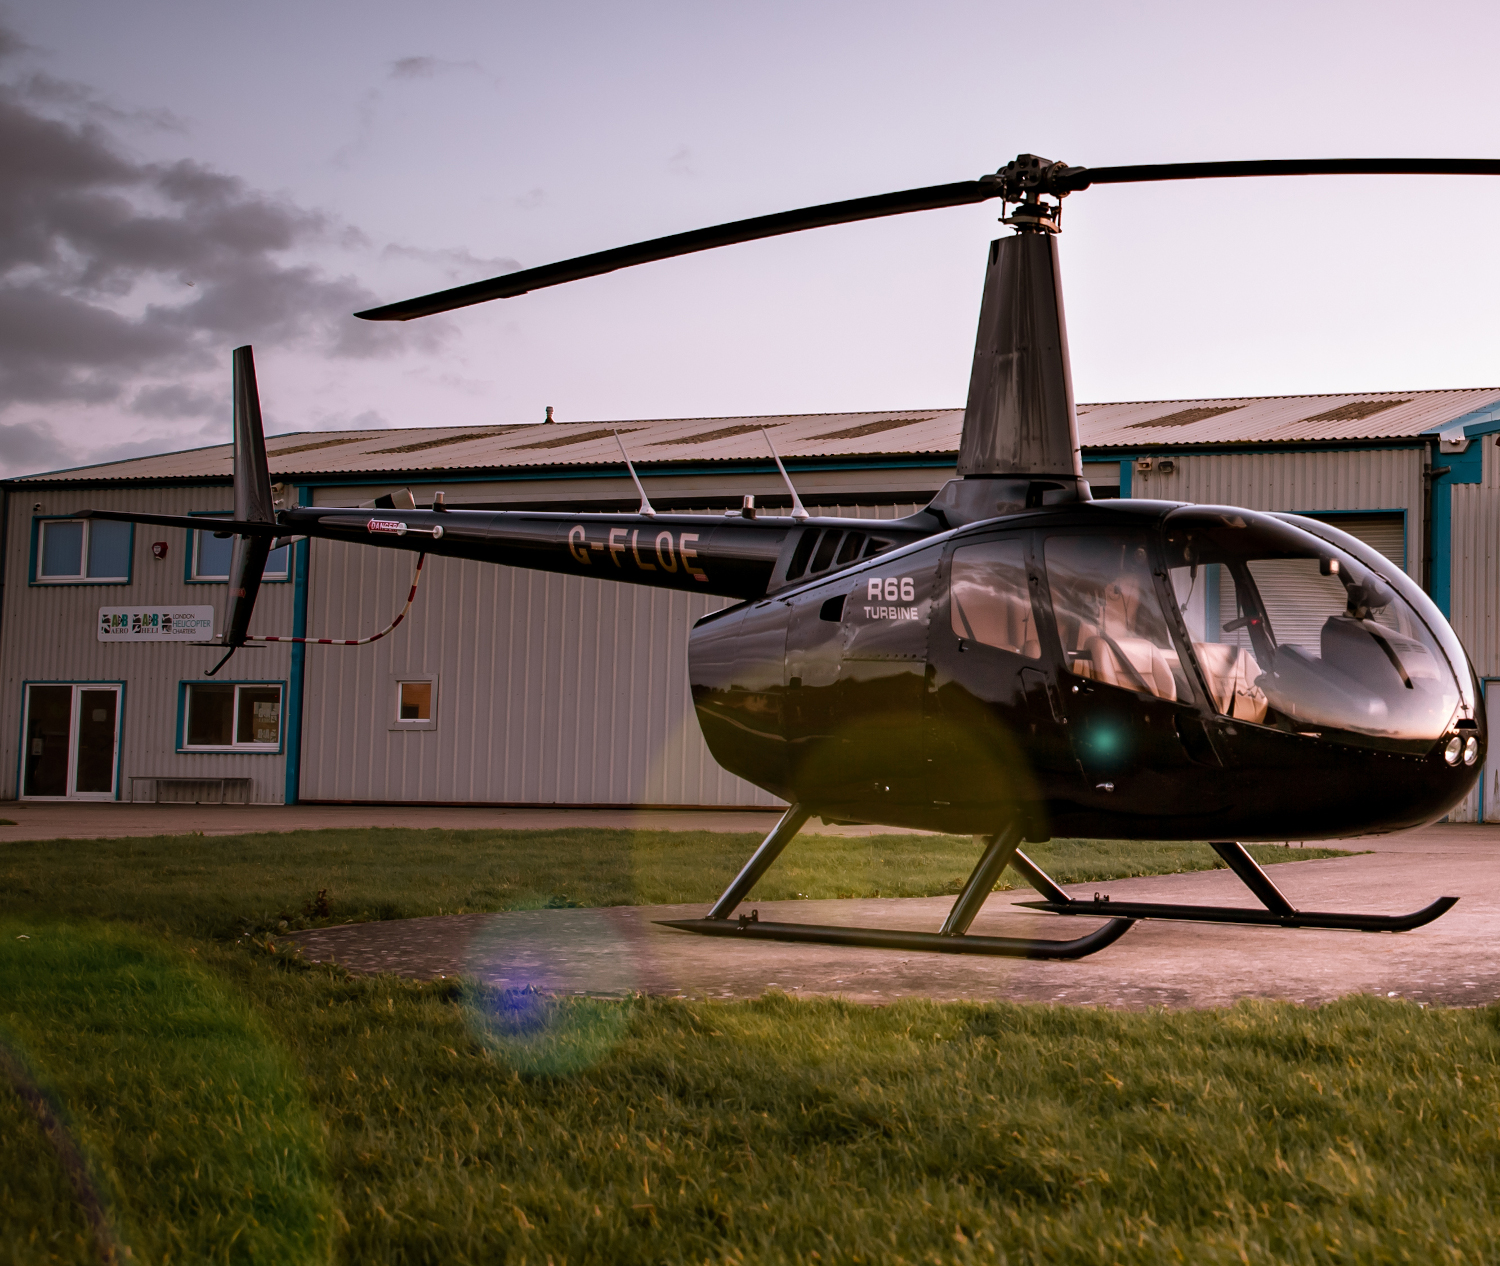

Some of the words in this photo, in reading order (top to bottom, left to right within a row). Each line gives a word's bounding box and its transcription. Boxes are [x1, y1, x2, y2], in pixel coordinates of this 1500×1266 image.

[371, 521, 399, 532] DANGER
[568, 525, 705, 574] G-FLOE
[867, 577, 915, 602] R66
[863, 606, 919, 620] TURBINE
[172, 619, 211, 628] HELICOPTER
